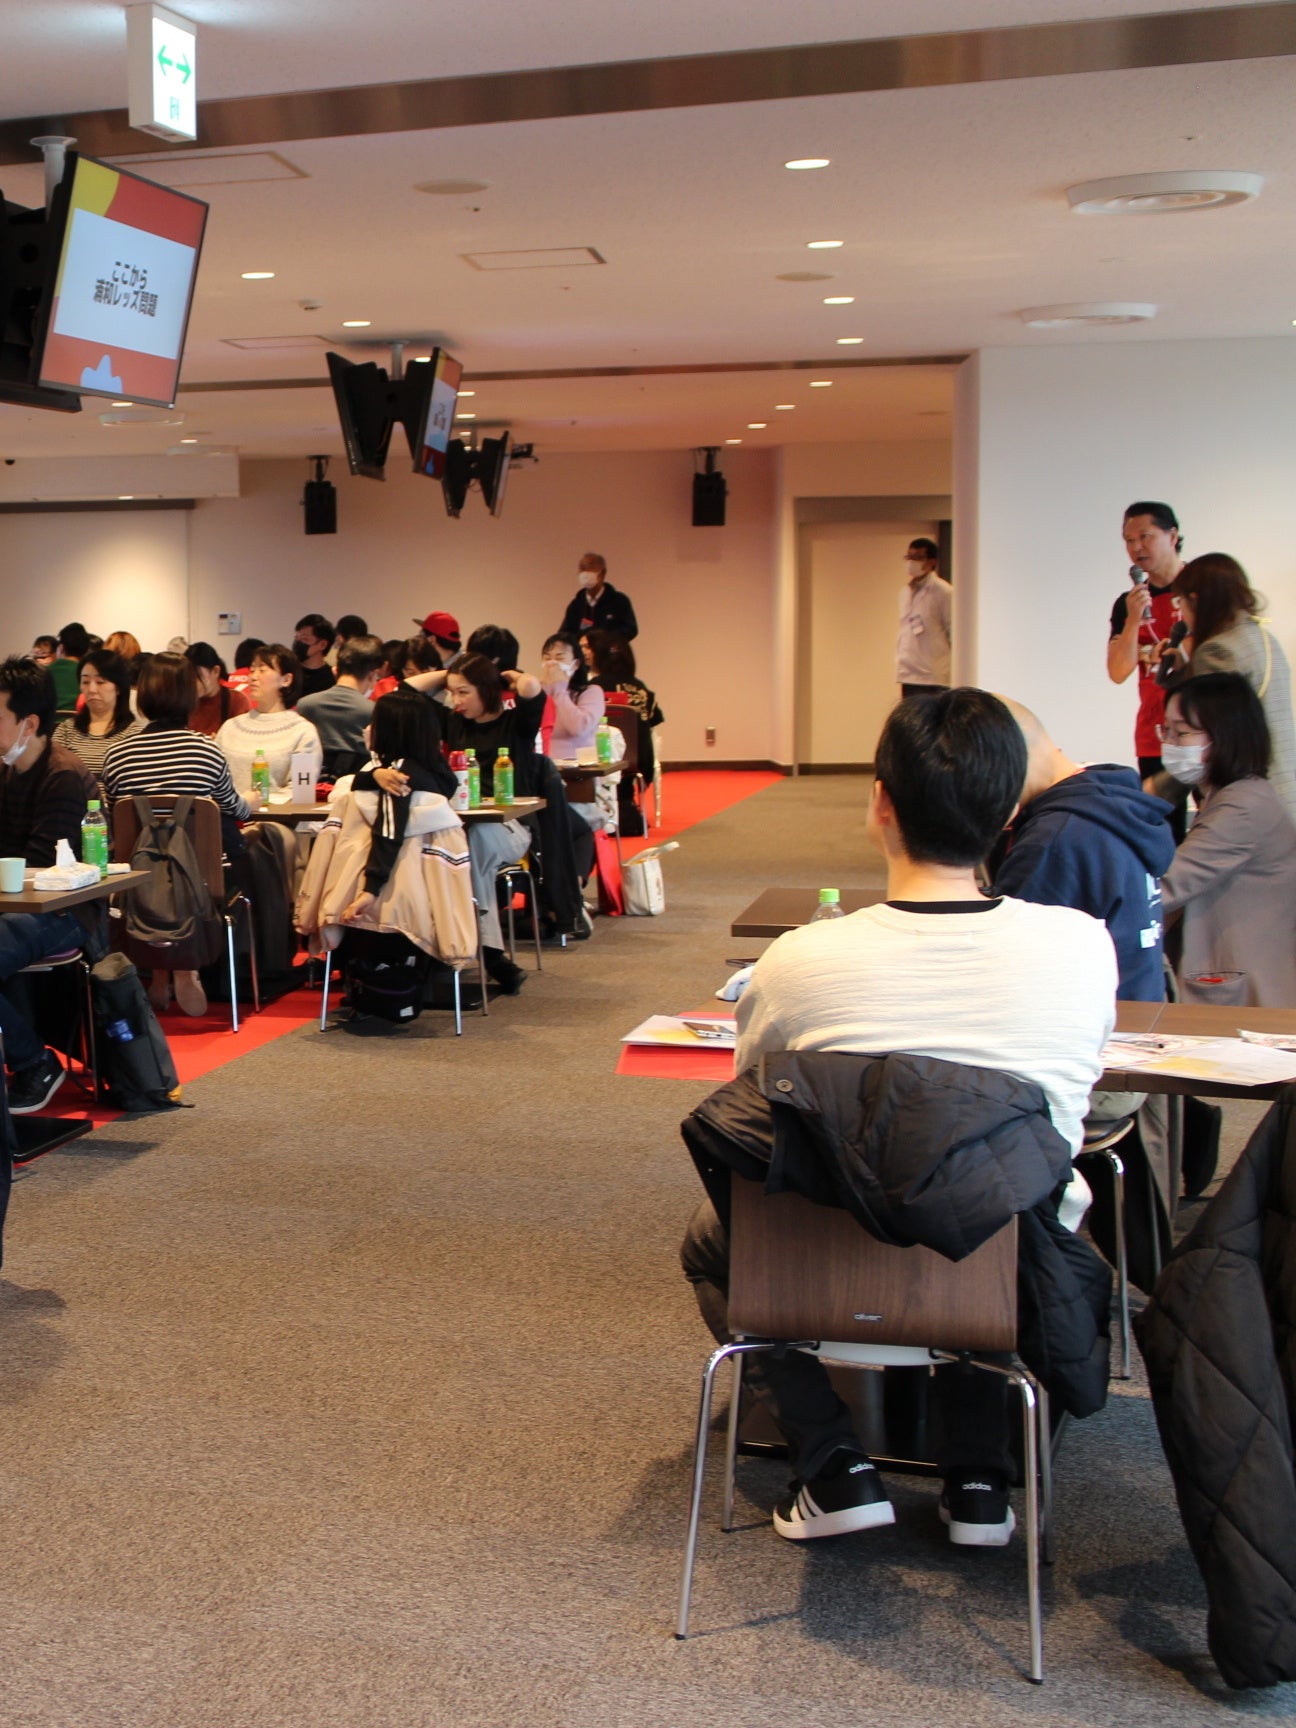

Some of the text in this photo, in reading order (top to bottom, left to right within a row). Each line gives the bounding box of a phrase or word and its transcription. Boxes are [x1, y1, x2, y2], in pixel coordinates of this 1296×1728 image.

[112, 261, 147, 290] ここから
[93, 279, 158, 317] 浦和レッズ問題
[298, 772, 310, 786] H
[962, 1482, 992, 1491] adidas
